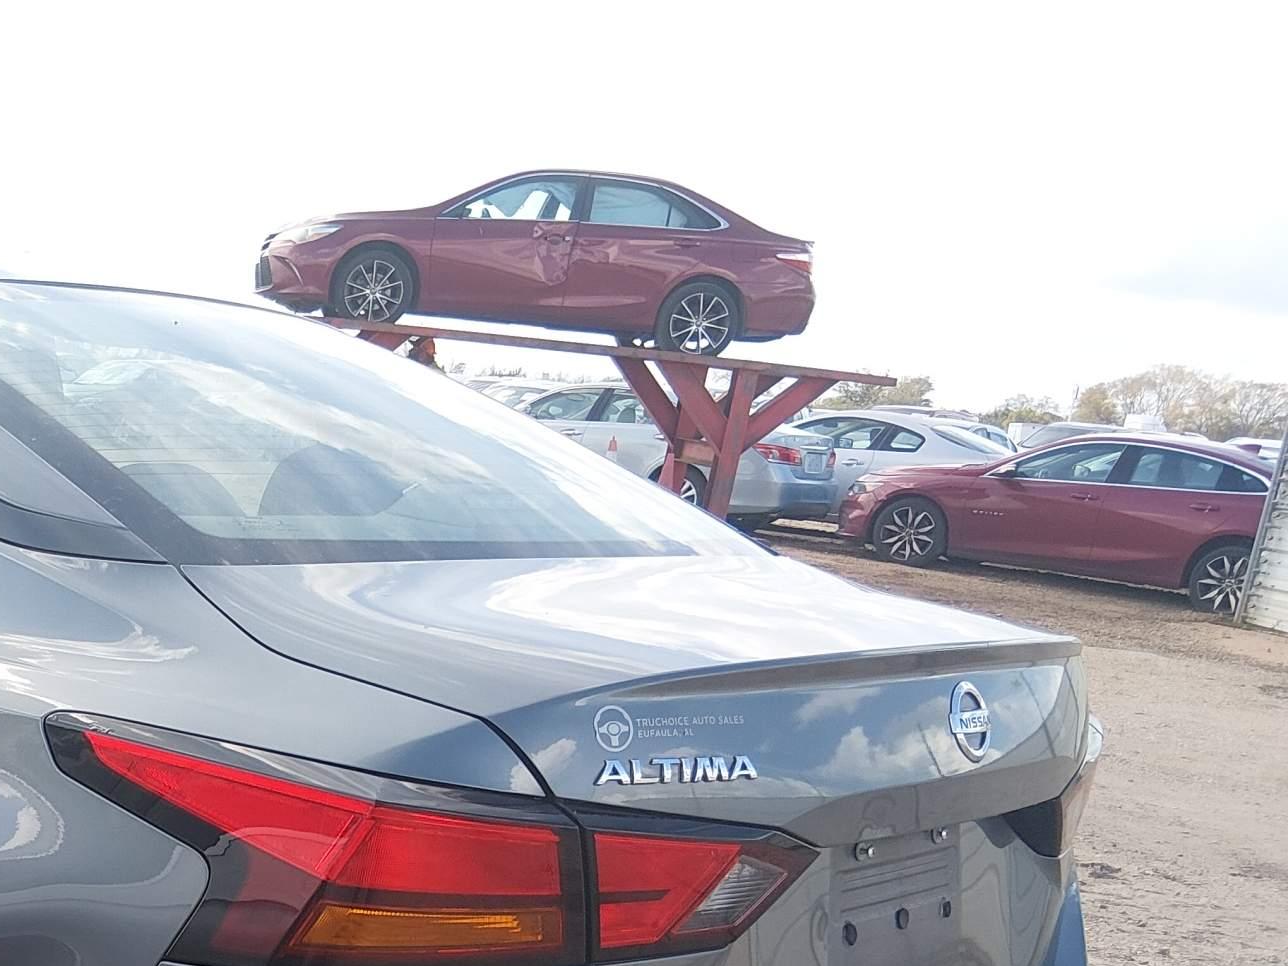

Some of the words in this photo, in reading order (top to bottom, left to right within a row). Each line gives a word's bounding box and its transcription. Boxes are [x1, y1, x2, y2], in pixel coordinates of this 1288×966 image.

[635, 716, 689, 728] TRUCHOICE
[692, 715, 716, 726] AUTO
[718, 714, 744, 726] SALES
[684, 728, 694, 737] AL
[594, 755, 758, 786] ALTIMA
